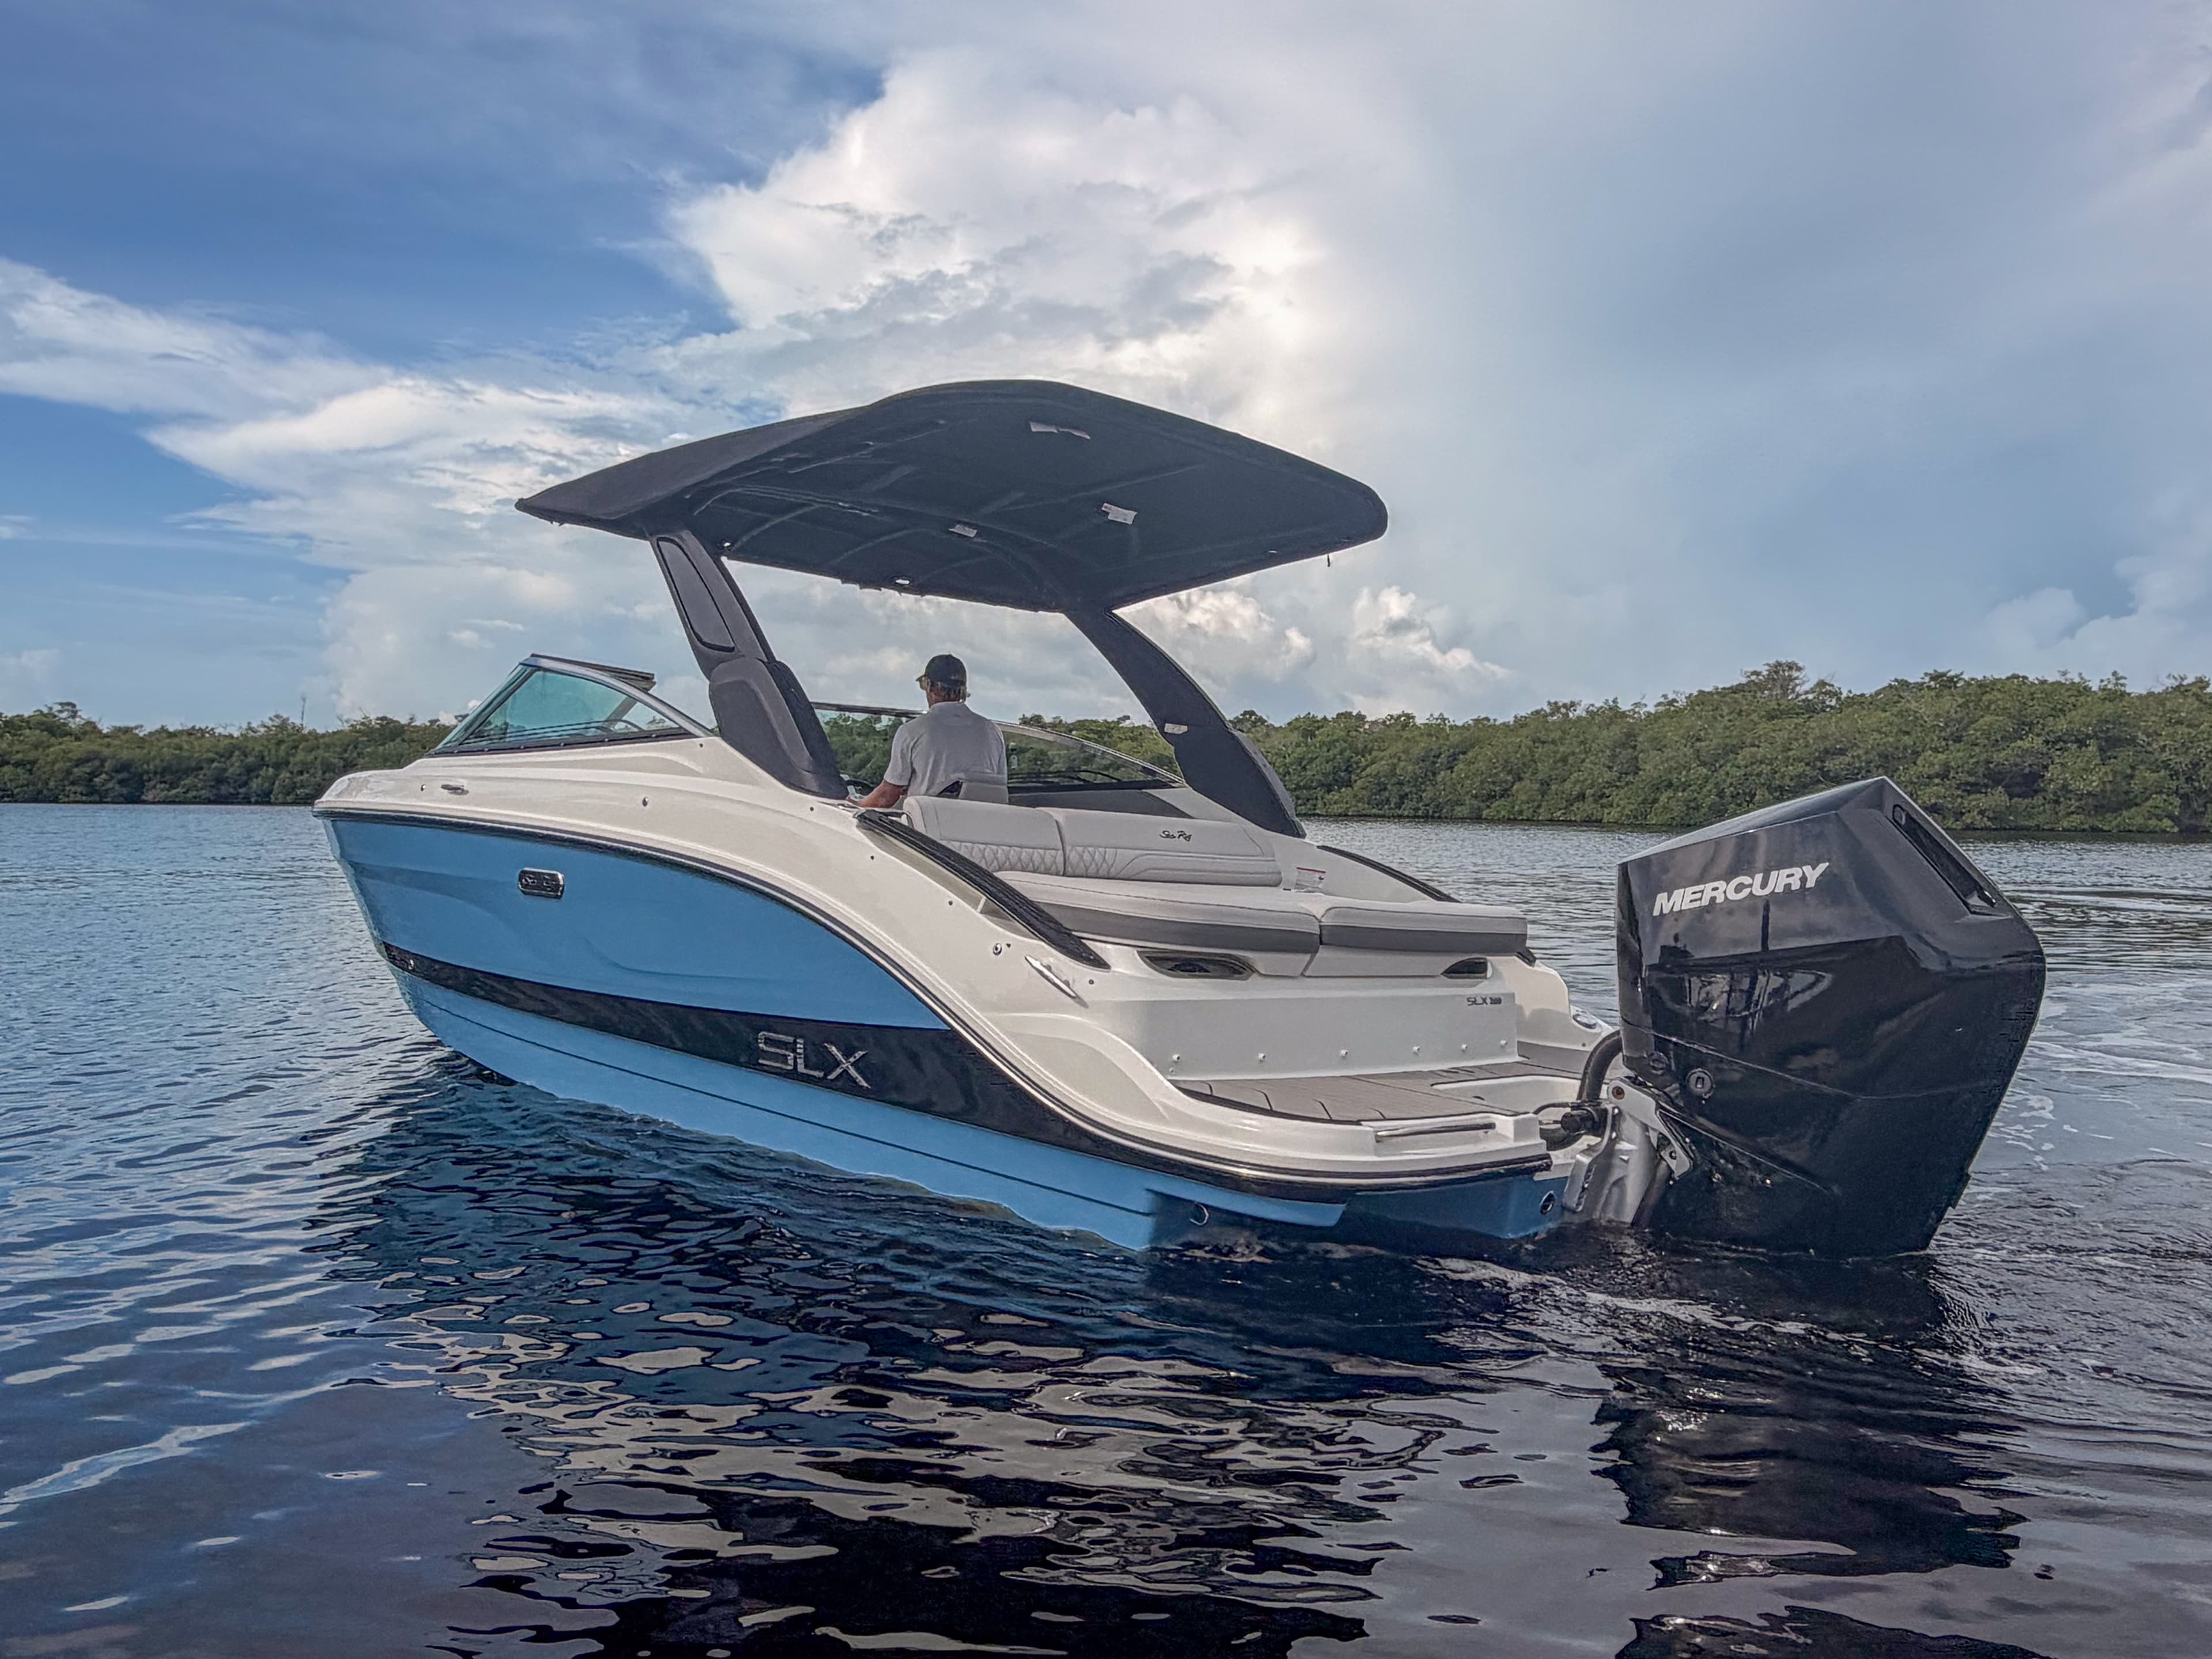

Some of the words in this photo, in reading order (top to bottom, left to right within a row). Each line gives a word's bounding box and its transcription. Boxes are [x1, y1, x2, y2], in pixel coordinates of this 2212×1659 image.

[1652, 862, 1830, 916] MERCURY
[1467, 996, 1488, 1006] SLX
[757, 1031, 872, 1089] SLX
